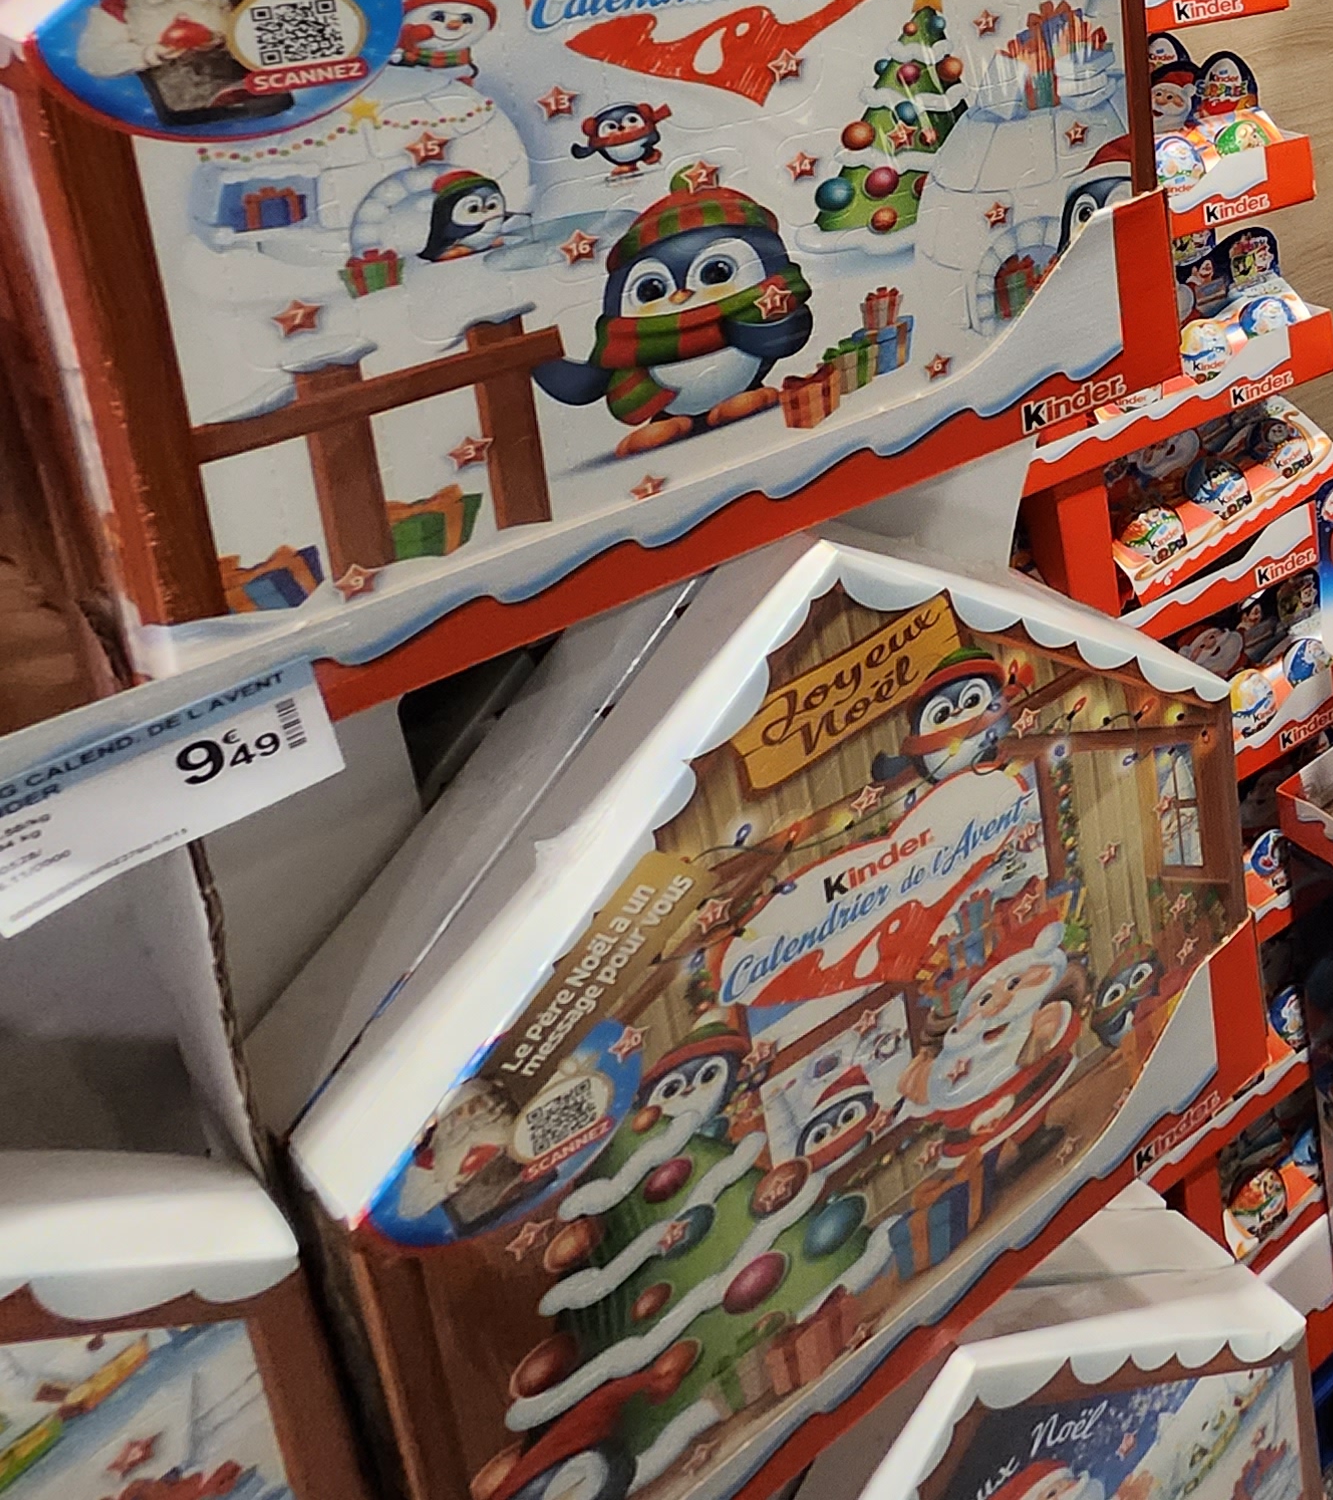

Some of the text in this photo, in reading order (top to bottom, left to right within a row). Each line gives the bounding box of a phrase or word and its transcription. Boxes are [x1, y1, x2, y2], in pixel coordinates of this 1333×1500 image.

[976, 17, 995, 30] 21
[253, 61, 363, 91] SCANNEZ
[776, 59, 798, 74] 24
[1209, 72, 1239, 82] Kinder
[547, 95, 571, 110] 13
[1068, 129, 1085, 141] 12
[415, 140, 441, 158] 15
[697, 169, 707, 183] 2
[791, 160, 813, 175] 14
[988, 209, 1006, 223] 23
[1206, 198, 1267, 222] Kinder
[570, 241, 591, 256] 16
[765, 294, 785, 309] 11
[932, 359, 943, 373] 6
[1233, 373, 1291, 405] Kinder
[1024, 375, 1120, 431] Kinder
[464, 444, 476, 458] 3
[1275, 448, 1303, 469] Kinder
[1219, 485, 1246, 506] Kinder
[1150, 526, 1180, 549] Kinder
[1257, 551, 1314, 586] Kinder
[350, 575, 365, 590] 9
[761, 608, 941, 749] Joyeux
[147, 670, 284, 738] DE L AVENT
[798, 652, 920, 758] Noël
[1019, 714, 1035, 729] 19
[823, 826, 933, 902] Kinder
[719, 792, 1034, 1004] Calendrier de l'Avent
[501, 884, 657, 1074] Le Père Noël a un
[521, 874, 694, 1078] message pour vous
[618, 1031, 642, 1050] 20
[1134, 1092, 1220, 1174] Kinder
[526, 1120, 612, 1178] SCANNEZ
[1030, 1400, 1109, 1458] Noël
